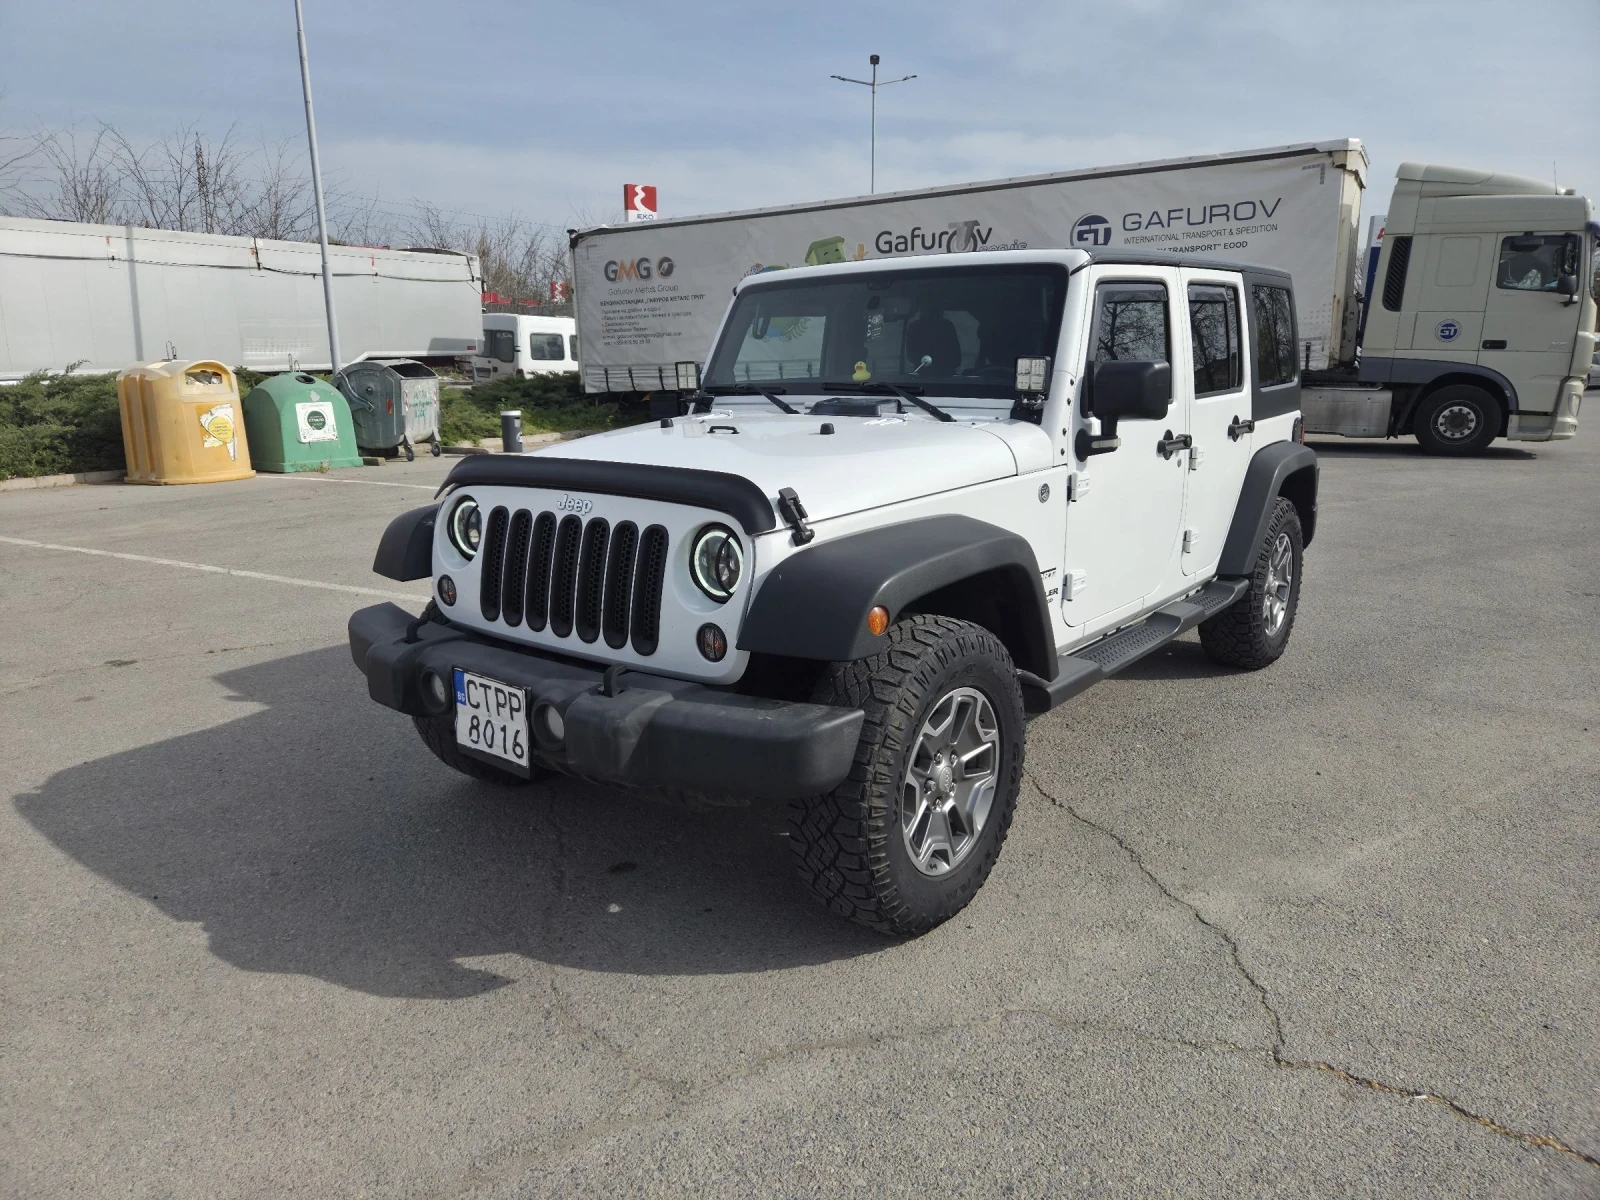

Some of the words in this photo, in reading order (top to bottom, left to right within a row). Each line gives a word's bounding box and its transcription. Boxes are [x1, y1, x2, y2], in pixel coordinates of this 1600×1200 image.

[1122, 197, 1282, 232] GAFUROV
[1124, 232, 1180, 245] INTERNATIONAL
[1181, 228, 1227, 240] TRANSPORT
[1228, 227, 1234, 236] &
[1235, 223, 1278, 235] SPEDITION
[1223, 240, 1248, 250] EOOD
[603, 257, 651, 282] GMG
[657, 284, 678, 293] Group
[557, 493, 593, 516] Jeep
[457, 691, 466, 702] BG
[466, 679, 522, 721] CTPP
[468, 714, 525, 759] 8016
